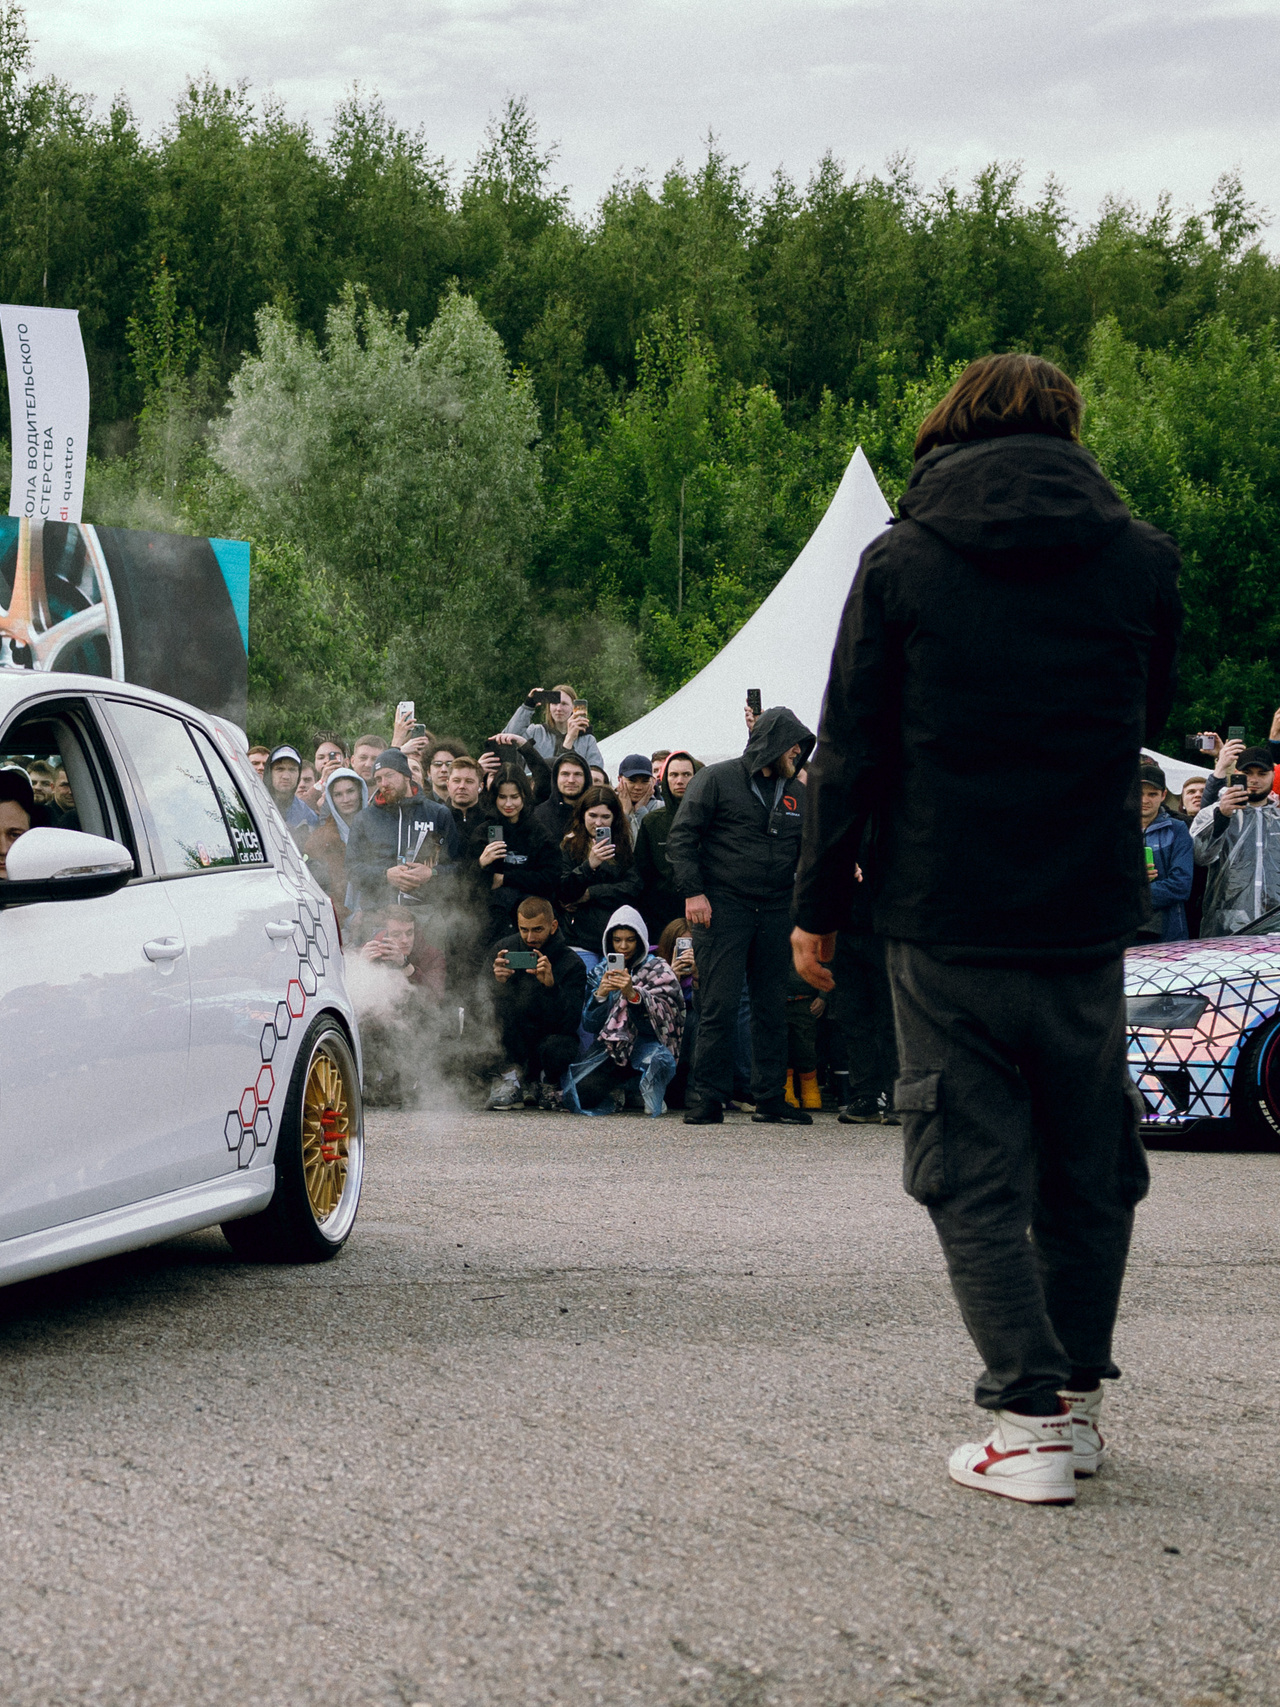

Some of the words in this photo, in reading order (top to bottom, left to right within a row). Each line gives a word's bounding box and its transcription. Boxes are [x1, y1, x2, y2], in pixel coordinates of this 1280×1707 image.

[17, 323, 40, 470] ВОДИТЕЛЬСКОГО
[63, 437, 74, 501] quattro
[231, 827, 259, 849] Pride
[414, 820, 434, 832] HH
